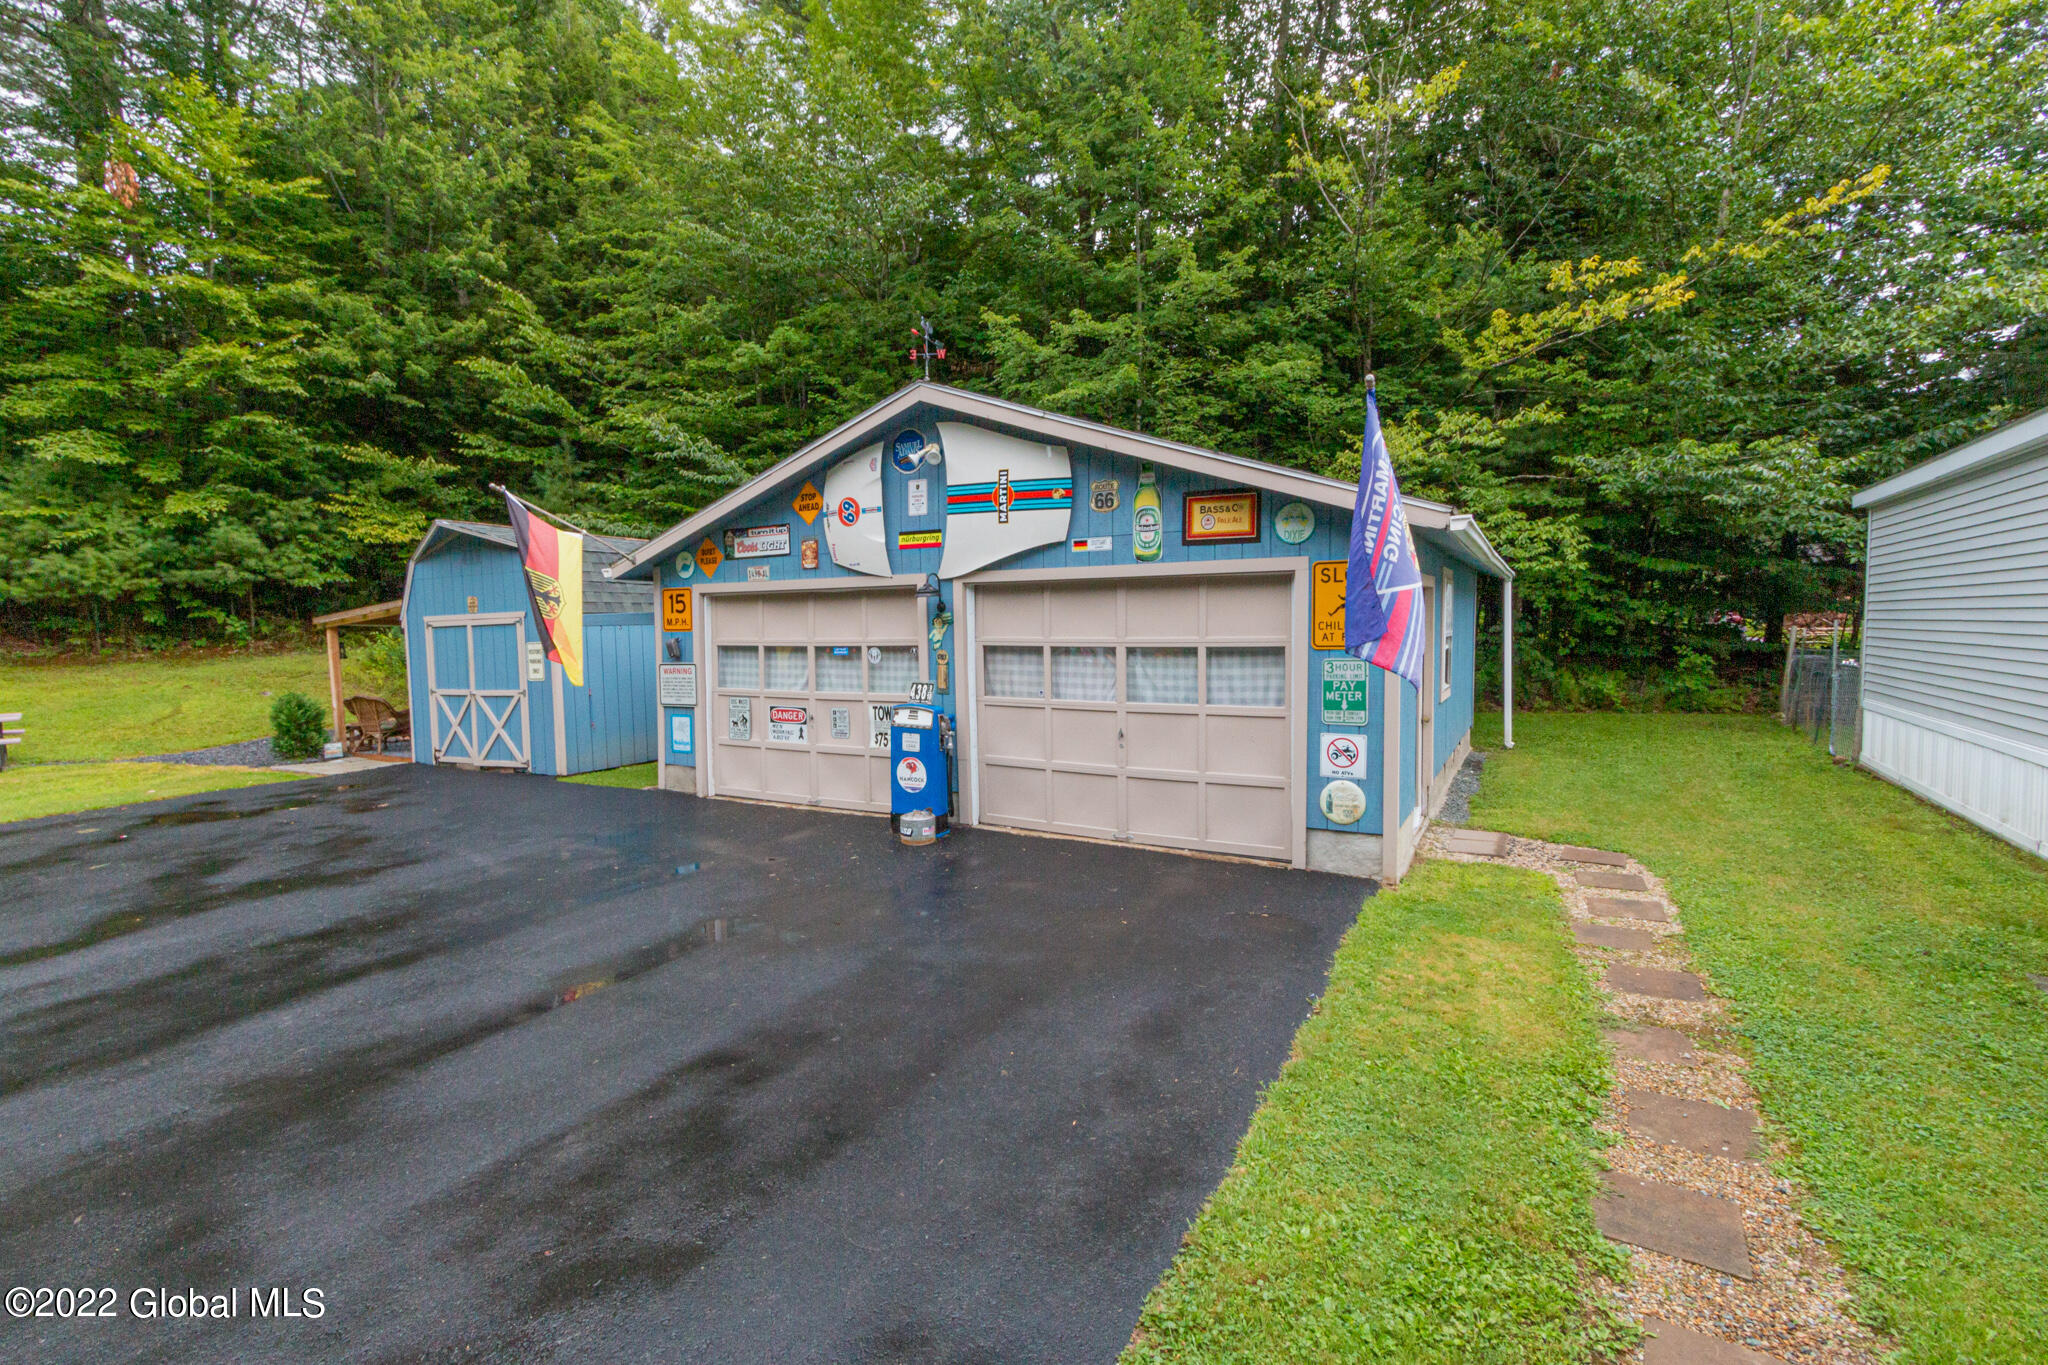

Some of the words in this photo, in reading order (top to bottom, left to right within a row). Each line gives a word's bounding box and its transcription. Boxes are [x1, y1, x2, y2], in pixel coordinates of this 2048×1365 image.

[895, 440, 922, 452] SAMUEL
[800, 493, 816, 502] STOP
[999, 471, 1008, 522] MARTINI
[1095, 492, 1115, 509] 66
[798, 502, 820, 512] AHEAD
[842, 500, 855, 523] 69
[1200, 505, 1225, 514] BASS
[901, 533, 940, 544] nürburgring
[1283, 529, 1305, 540] DIXIE
[759, 540, 787, 552] LIGHT
[668, 594, 686, 614] 15
[666, 618, 689, 626] M.P.H.
[1321, 632, 1335, 642] AT
[663, 667, 693, 675] WARNING
[1326, 662, 1334, 674] 3
[1335, 663, 1363, 672] HOUR
[1333, 680, 1356, 691] PAY
[1326, 691, 1363, 702] METER
[772, 710, 804, 721] DANGER
[874, 732, 889, 748] $75
